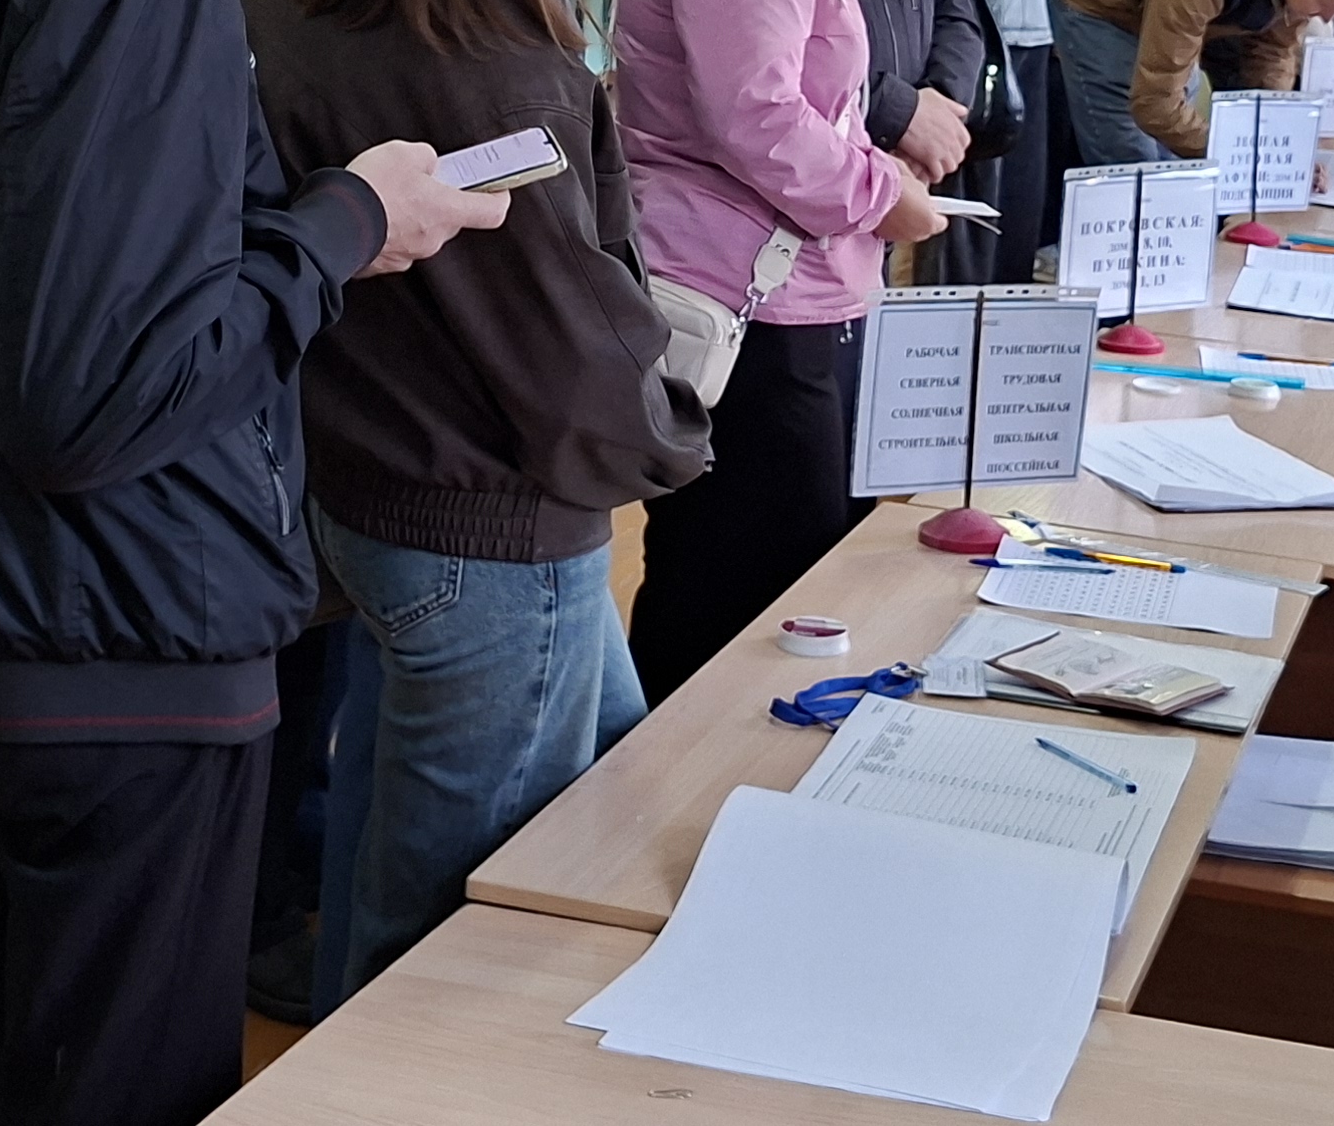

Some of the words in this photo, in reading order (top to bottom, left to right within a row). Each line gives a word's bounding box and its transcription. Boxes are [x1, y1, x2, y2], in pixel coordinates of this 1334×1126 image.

[989, 344, 1083, 356] ТРАНСПОРТНАЯ
[1002, 374, 1062, 385] ТРУДОВАЯ
[987, 402, 1071, 415] ЦЕНТРАЛЬНАЯ
[993, 431, 1060, 444] ШКОЛЬНАЯ
